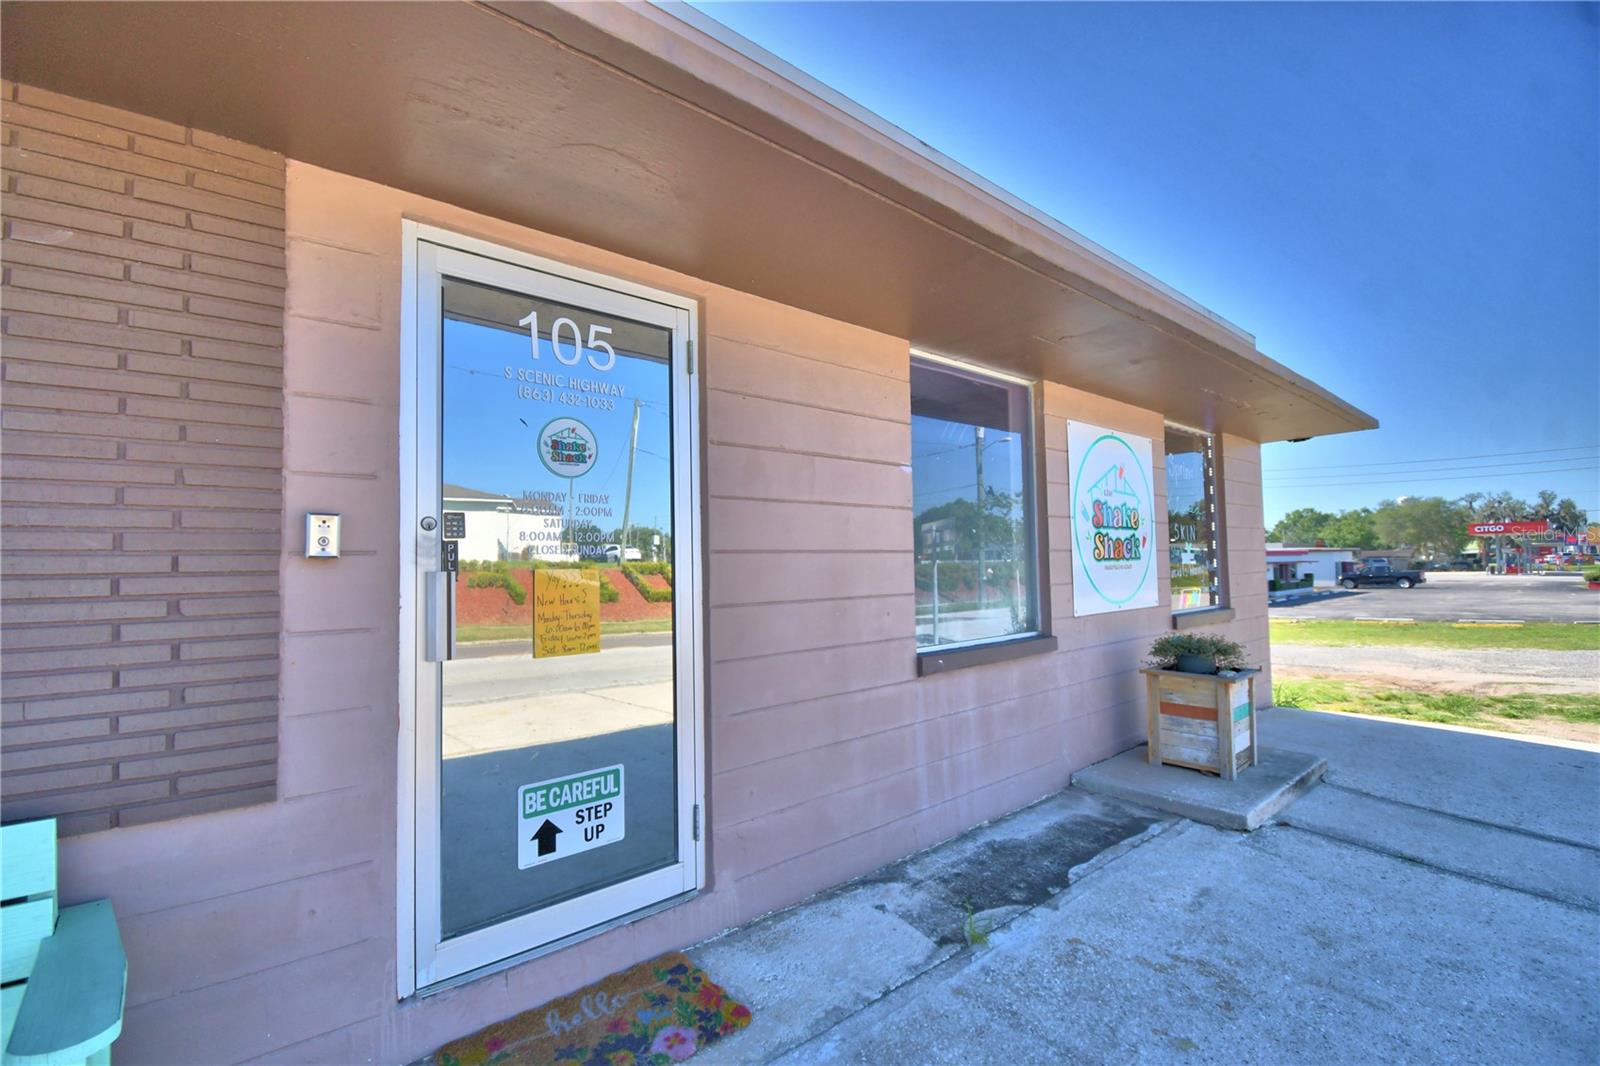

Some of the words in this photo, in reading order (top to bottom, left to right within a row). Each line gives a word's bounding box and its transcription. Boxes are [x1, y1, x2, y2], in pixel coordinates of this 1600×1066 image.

[518, 310, 617, 372] 105
[504, 366, 512, 379] S
[517, 368, 566, 387] SCENIC
[568, 378, 626, 397] HIGHWAY
[517, 385, 554, 403] (863)
[559, 392, 616, 411] 432-1033
[550, 439, 586, 453] Shake
[551, 451, 587, 464] Shack
[522, 490, 567, 502] MONDAY
[578, 493, 610, 504] FRIDAY
[575, 506, 612, 517] 2:00PM
[1092, 499, 1140, 530] Shake
[543, 518, 592, 529] SATURDAY
[1174, 523, 1196, 541] SKIN
[1474, 524, 1504, 533] CITGO
[519, 531, 562, 542] 8:00AM
[575, 532, 615, 543] 12:00PM
[1093, 532, 1141, 562] Shack
[447, 543, 455, 571] PUL
[525, 789, 547, 815] BE
[549, 773, 619, 808] CAREFUL
[575, 802, 613, 825] STEP
[584, 823, 605, 842] UP
[546, 991, 627, 1035] hello
